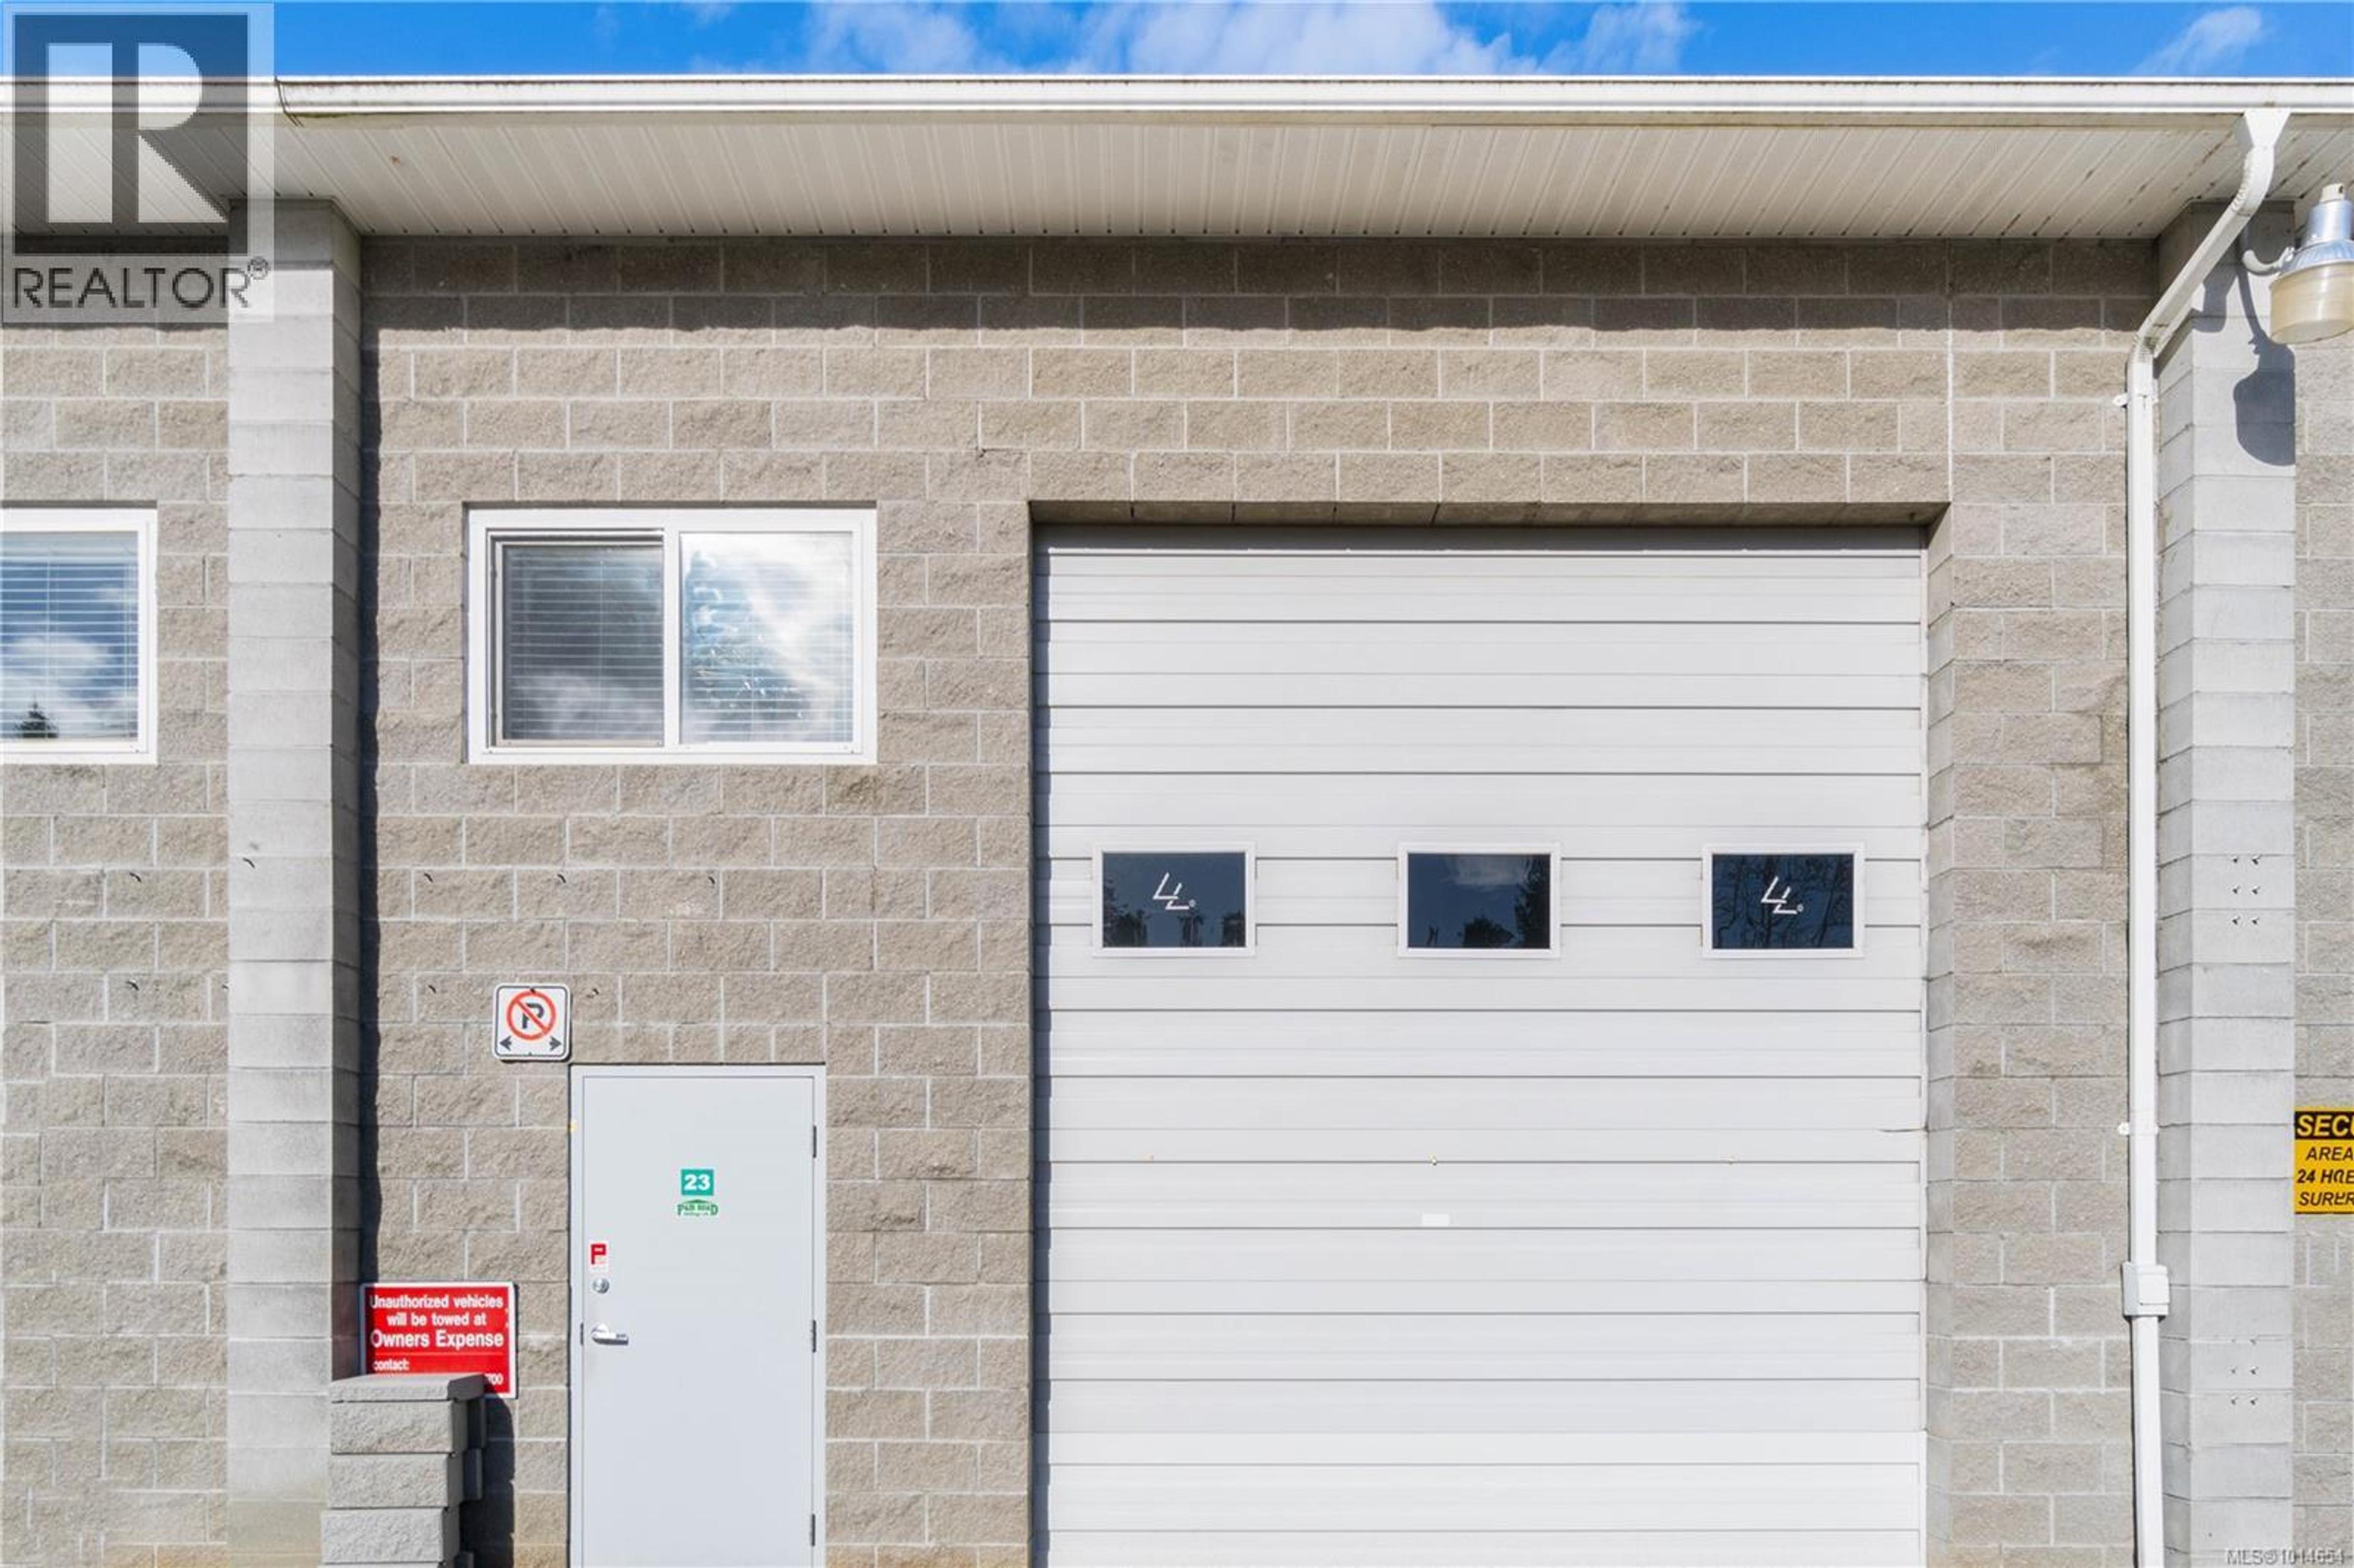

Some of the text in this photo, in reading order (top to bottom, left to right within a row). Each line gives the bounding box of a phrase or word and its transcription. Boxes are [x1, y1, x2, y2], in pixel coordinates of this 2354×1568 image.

[2297, 1114, 2354, 1137] SEC
[2306, 1146, 2354, 1161] AREA
[684, 1173, 710, 1190] 23
[2296, 1168, 2316, 1184] 24
[370, 1295, 504, 1309] Unauthorized vehicles
[387, 1312, 487, 1326] will be towed at
[371, 1329, 504, 1350] Owners Expense
